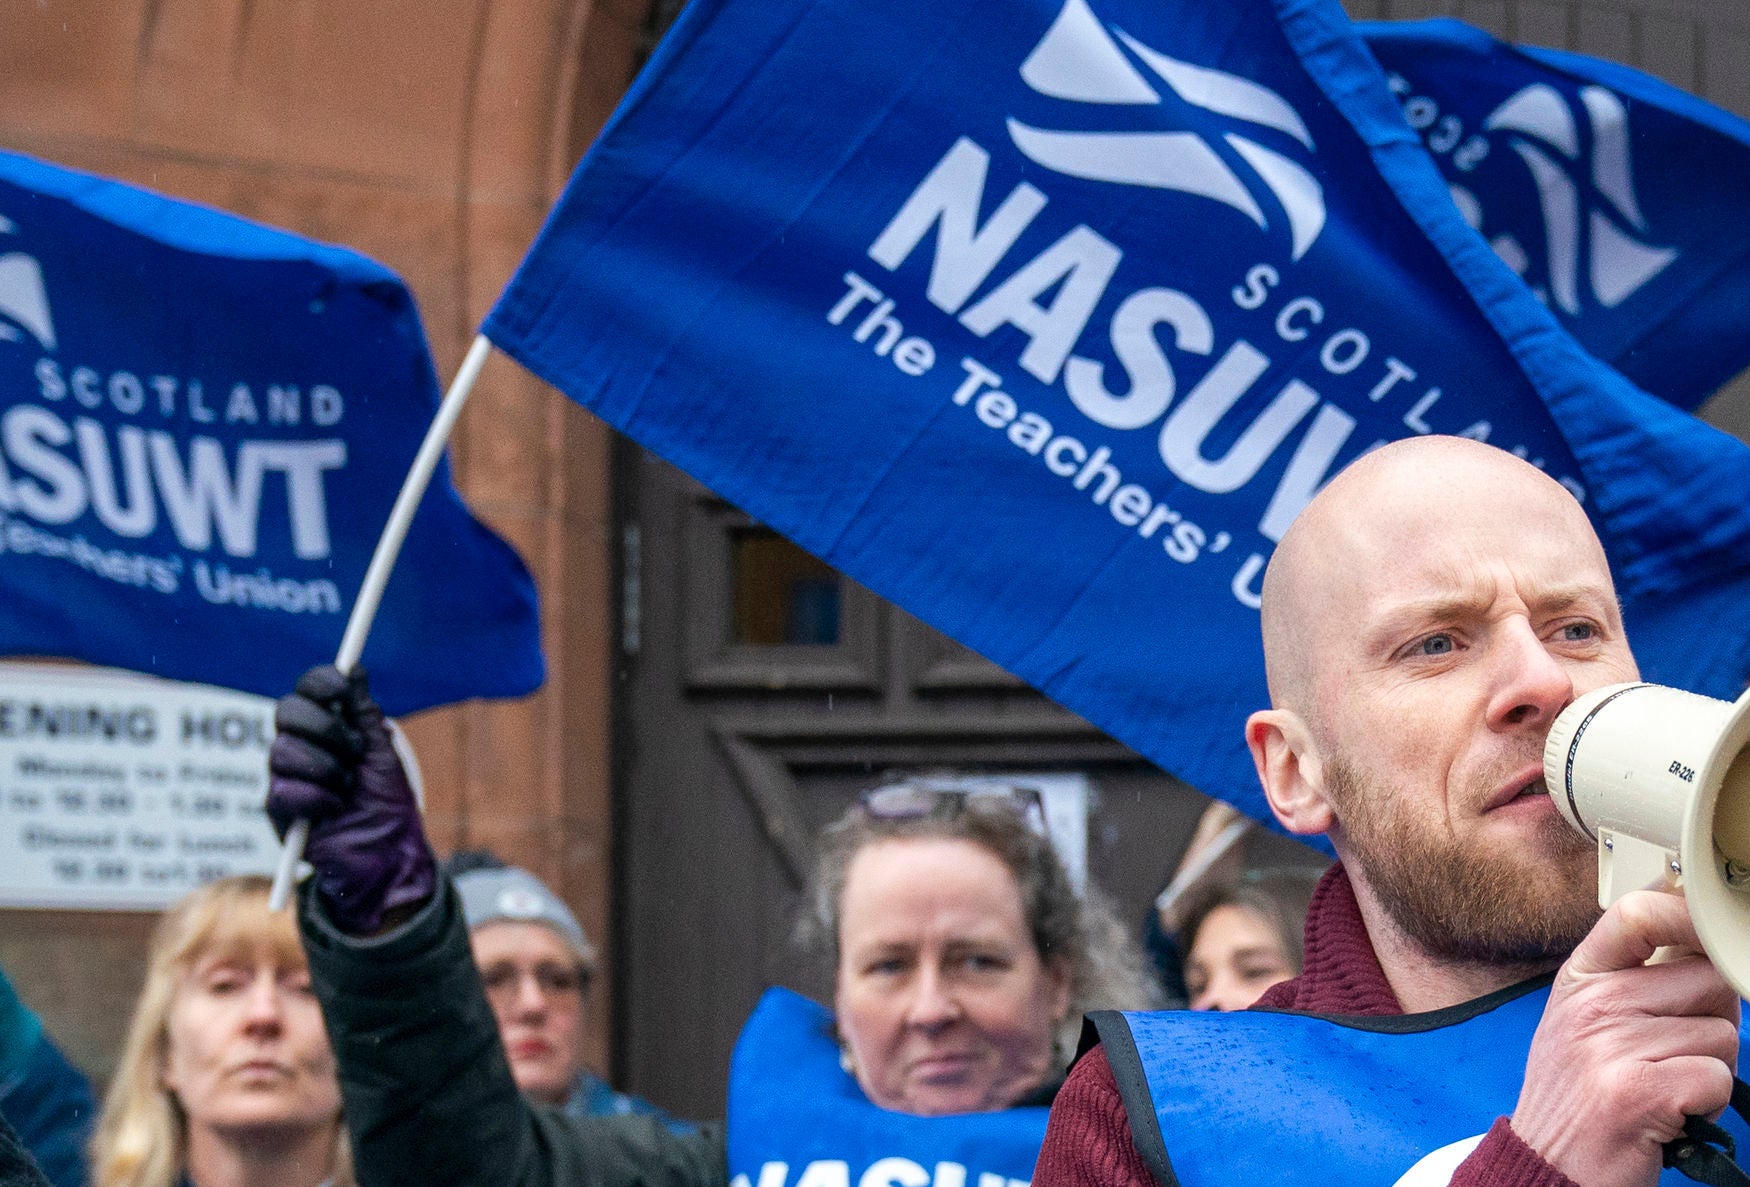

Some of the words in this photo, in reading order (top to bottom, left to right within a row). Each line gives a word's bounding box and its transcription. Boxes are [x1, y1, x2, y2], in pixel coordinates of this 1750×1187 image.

[34, 357, 345, 426] SCOTLAND
[826, 272, 936, 376] The
[952, 357, 1231, 564] Teachers'
[0, 403, 348, 561] SUWT
[194, 557, 343, 614] Union
